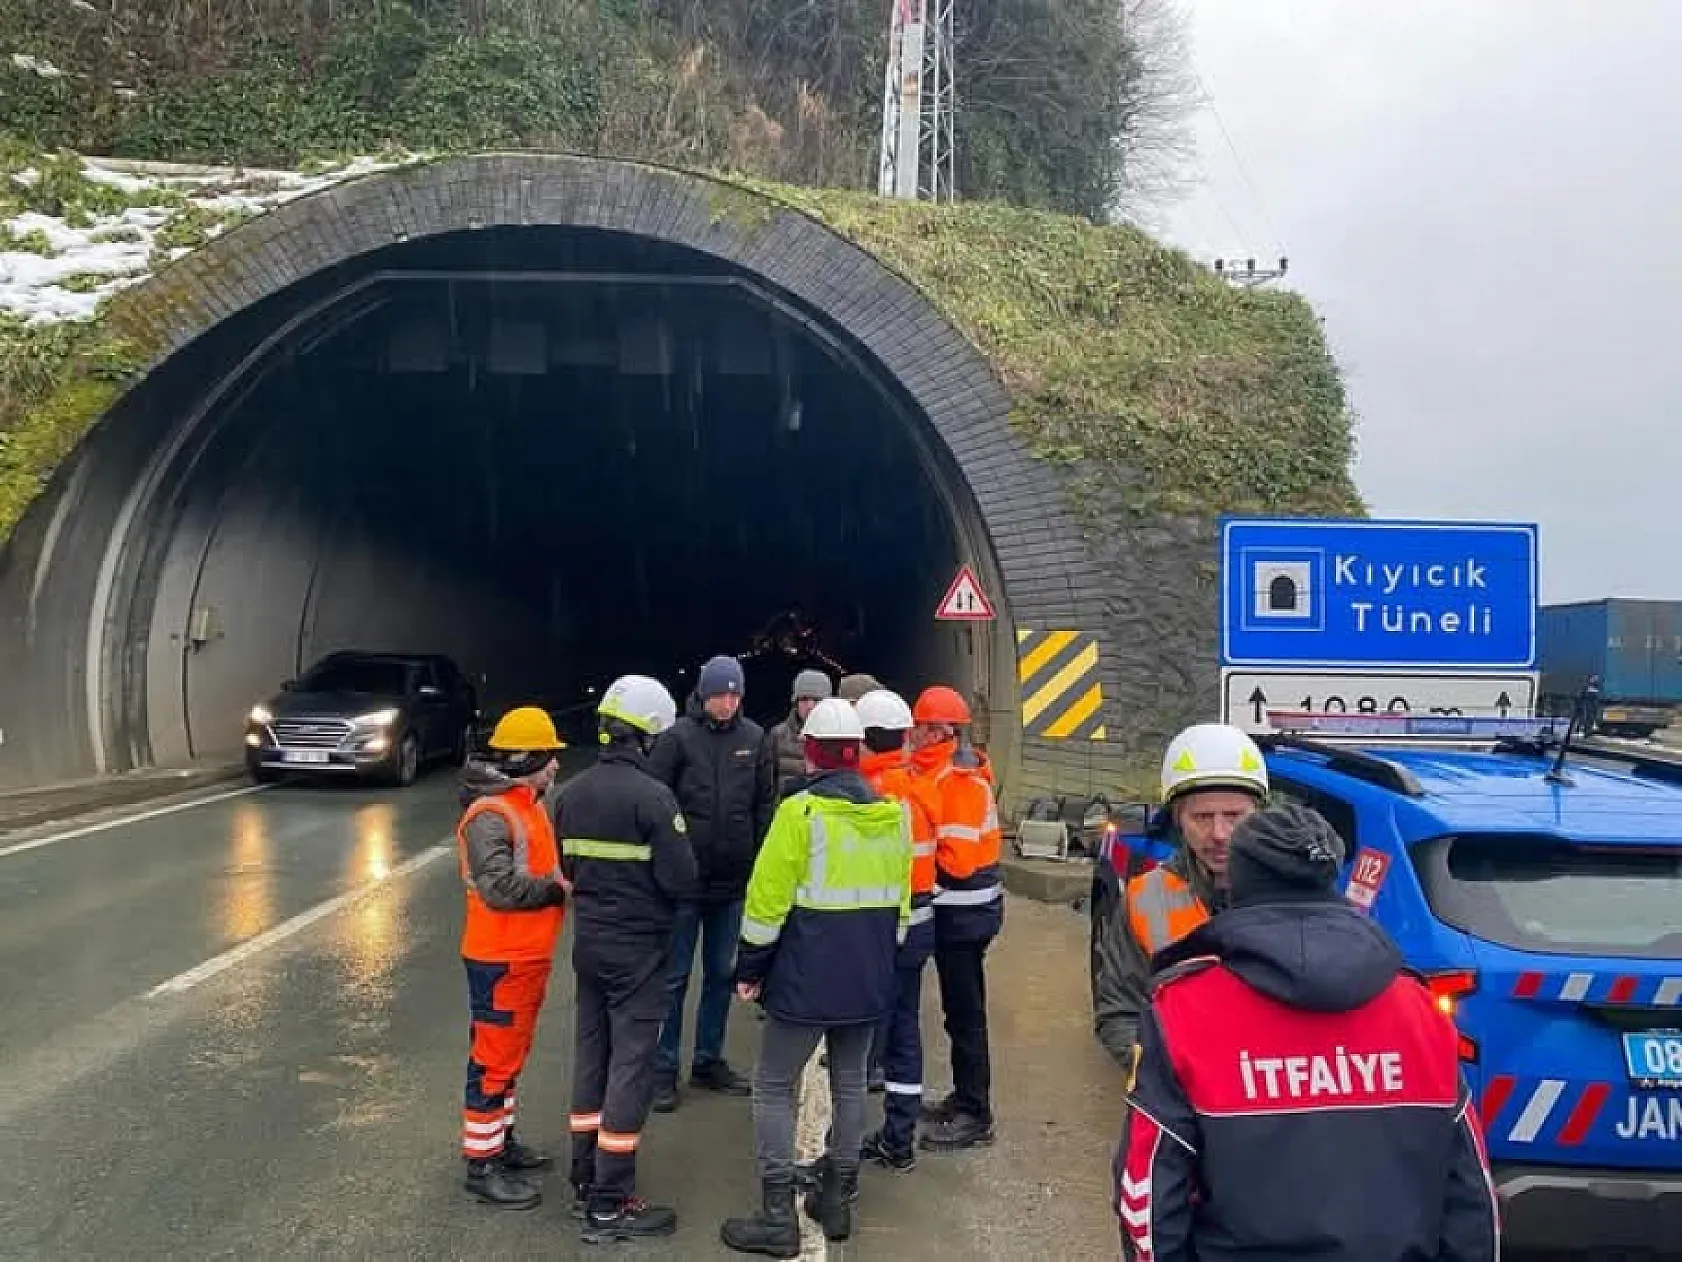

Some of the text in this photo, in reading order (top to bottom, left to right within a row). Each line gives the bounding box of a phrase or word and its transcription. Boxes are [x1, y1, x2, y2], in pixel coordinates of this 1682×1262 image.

[1335, 553, 1487, 595] Kıyıcık
[1352, 602, 1493, 635] Tüneli
[1239, 1046, 1403, 1099] İTFAİYE
[1644, 1039, 1682, 1074] 08
